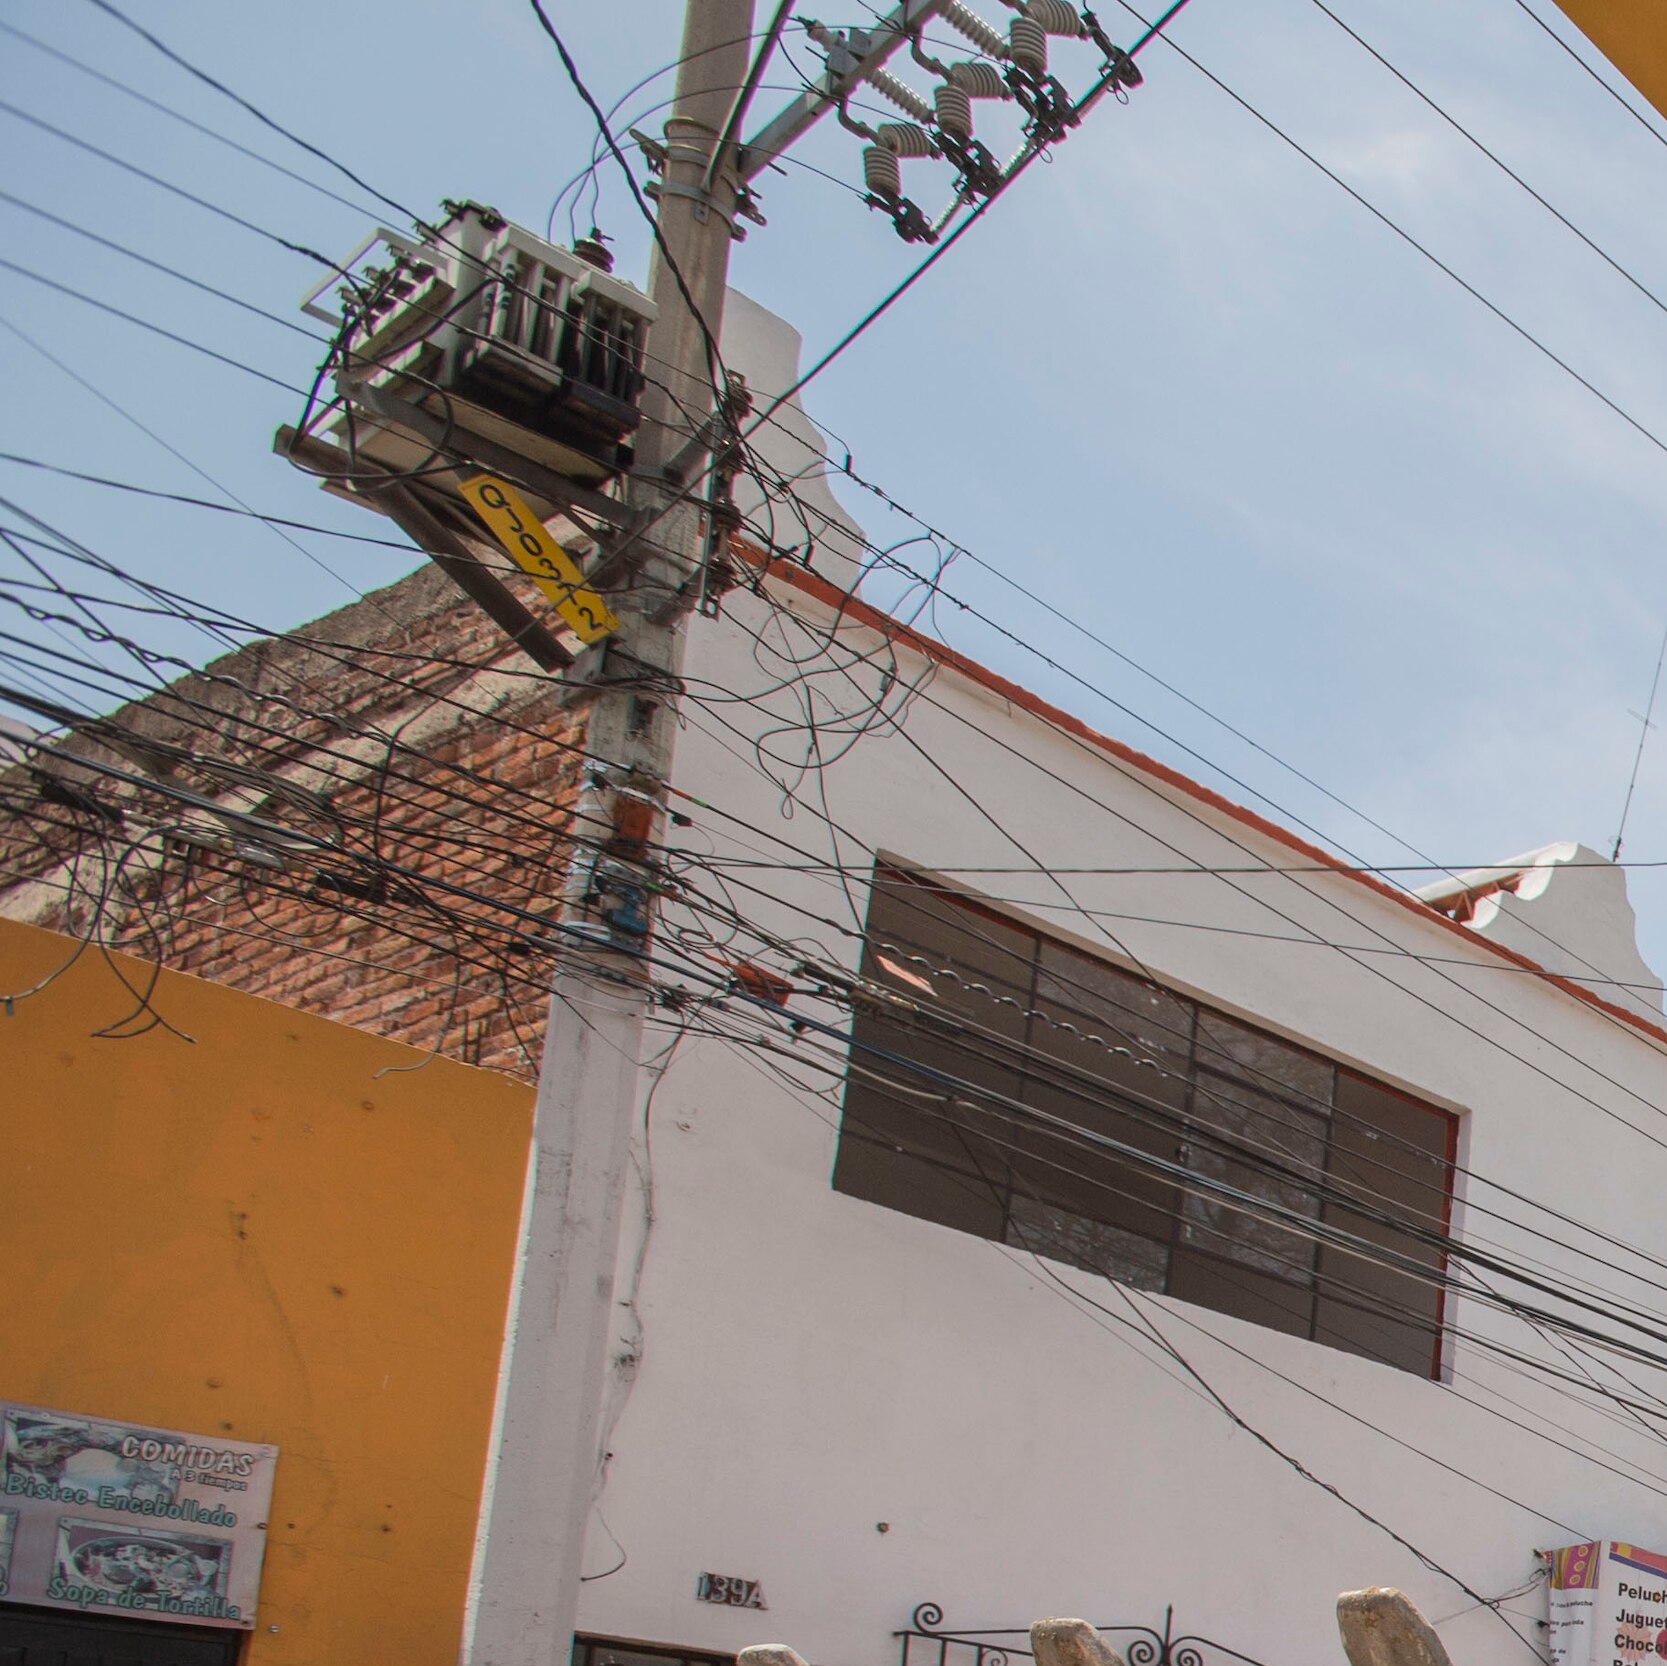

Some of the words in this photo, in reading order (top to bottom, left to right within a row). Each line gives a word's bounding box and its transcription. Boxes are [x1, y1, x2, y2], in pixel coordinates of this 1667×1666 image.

[121, 1435, 254, 1476] COMIDAS
[5, 1473, 89, 1506] Bistec
[98, 1486, 238, 1528] Encebollado
[47, 1577, 110, 1608] Sopa
[118, 1588, 145, 1609] de
[155, 1590, 241, 1620] Tortilla
[695, 1572, 768, 1610] 139A
